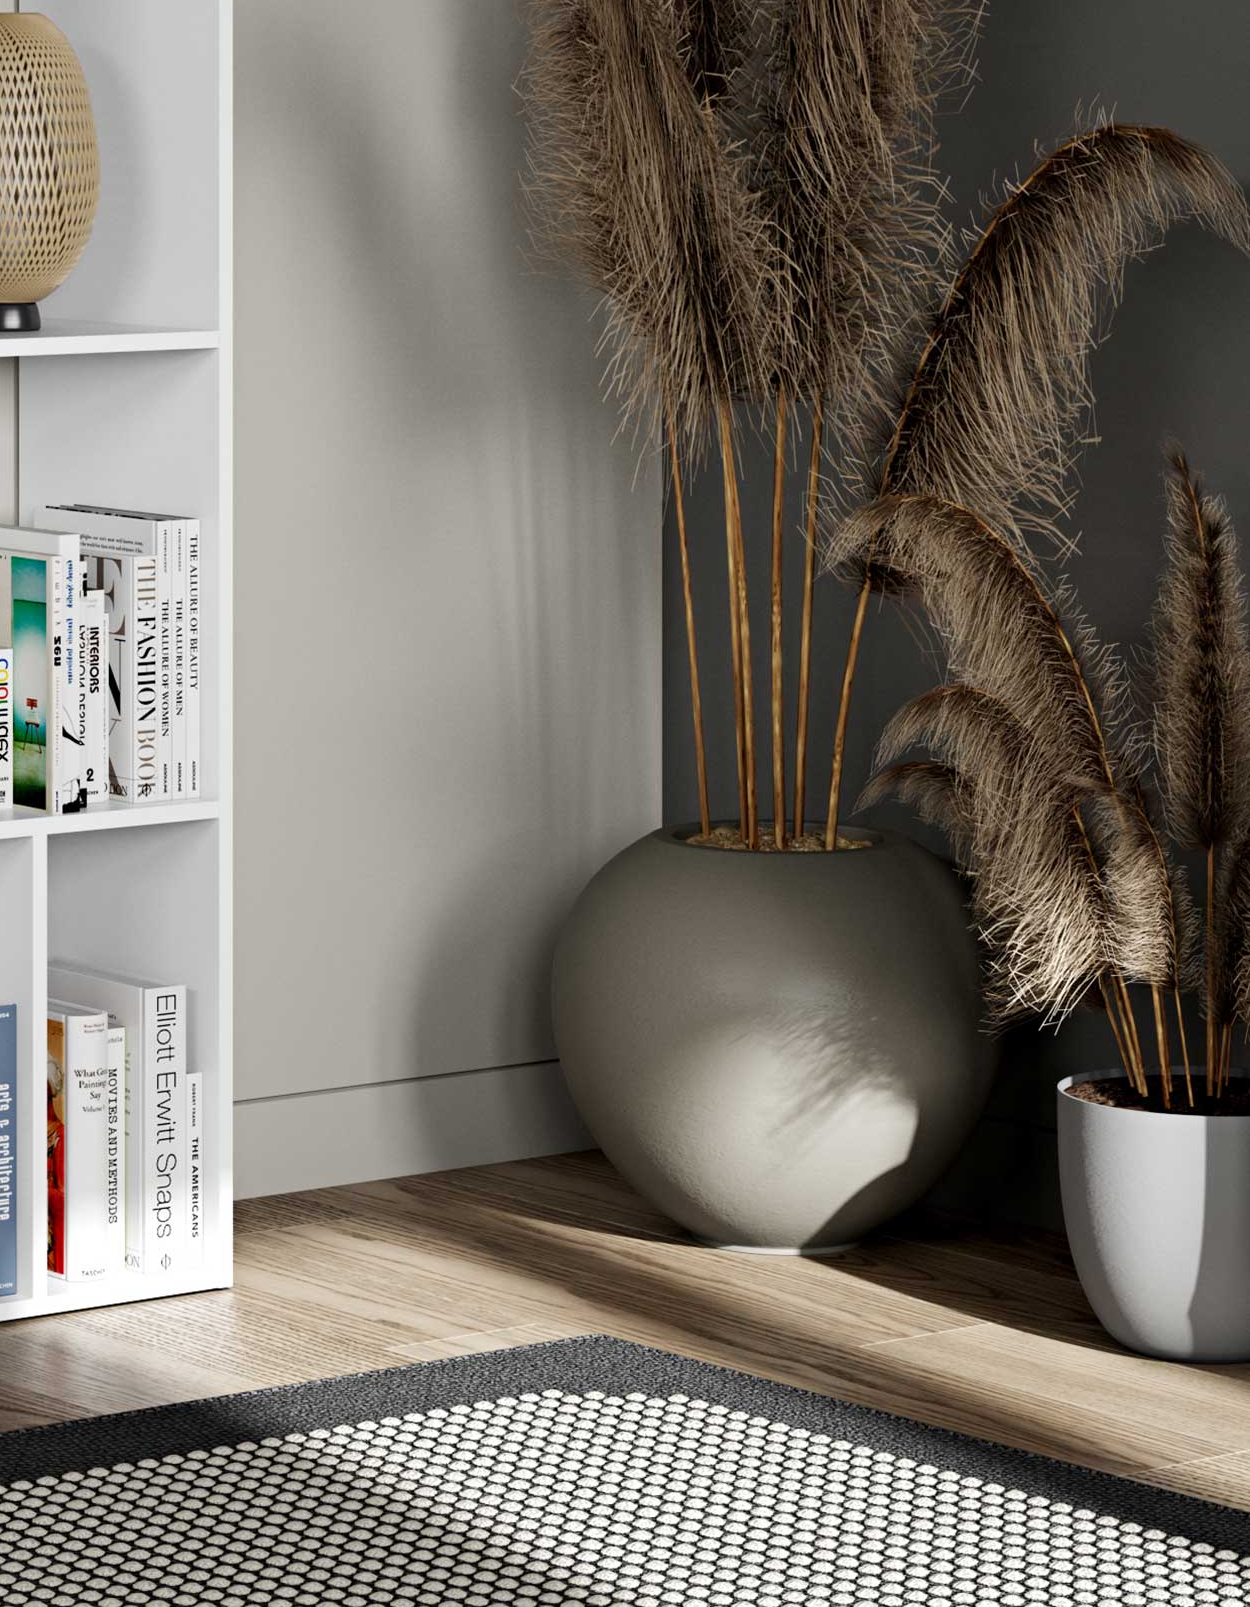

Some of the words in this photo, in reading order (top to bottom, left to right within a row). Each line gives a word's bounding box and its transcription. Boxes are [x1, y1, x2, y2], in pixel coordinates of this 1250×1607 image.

[189, 535, 198, 562] THE
[137, 559, 156, 611] THE
[161, 599, 169, 621] THE
[189, 564, 198, 615] ALLURE
[161, 625, 169, 670] ALLURE
[189, 619, 198, 635] OF
[89, 627, 100, 694] INTERIORS
[137, 617, 156, 722] FASHION
[161, 673, 169, 688] OF
[176, 672, 183, 687] OF
[189, 638, 198, 690] BEAUTY
[161, 689, 169, 737] WOMEN
[86, 768, 94, 781] 2
[155, 994, 176, 1061] Elliott
[108, 1068, 117, 1124] MOVIES
[155, 1071, 176, 1145] Erwitt
[108, 1128, 117, 1156] AND
[108, 1159, 117, 1224] METHODS
[154, 1153, 177, 1239] Snaps
